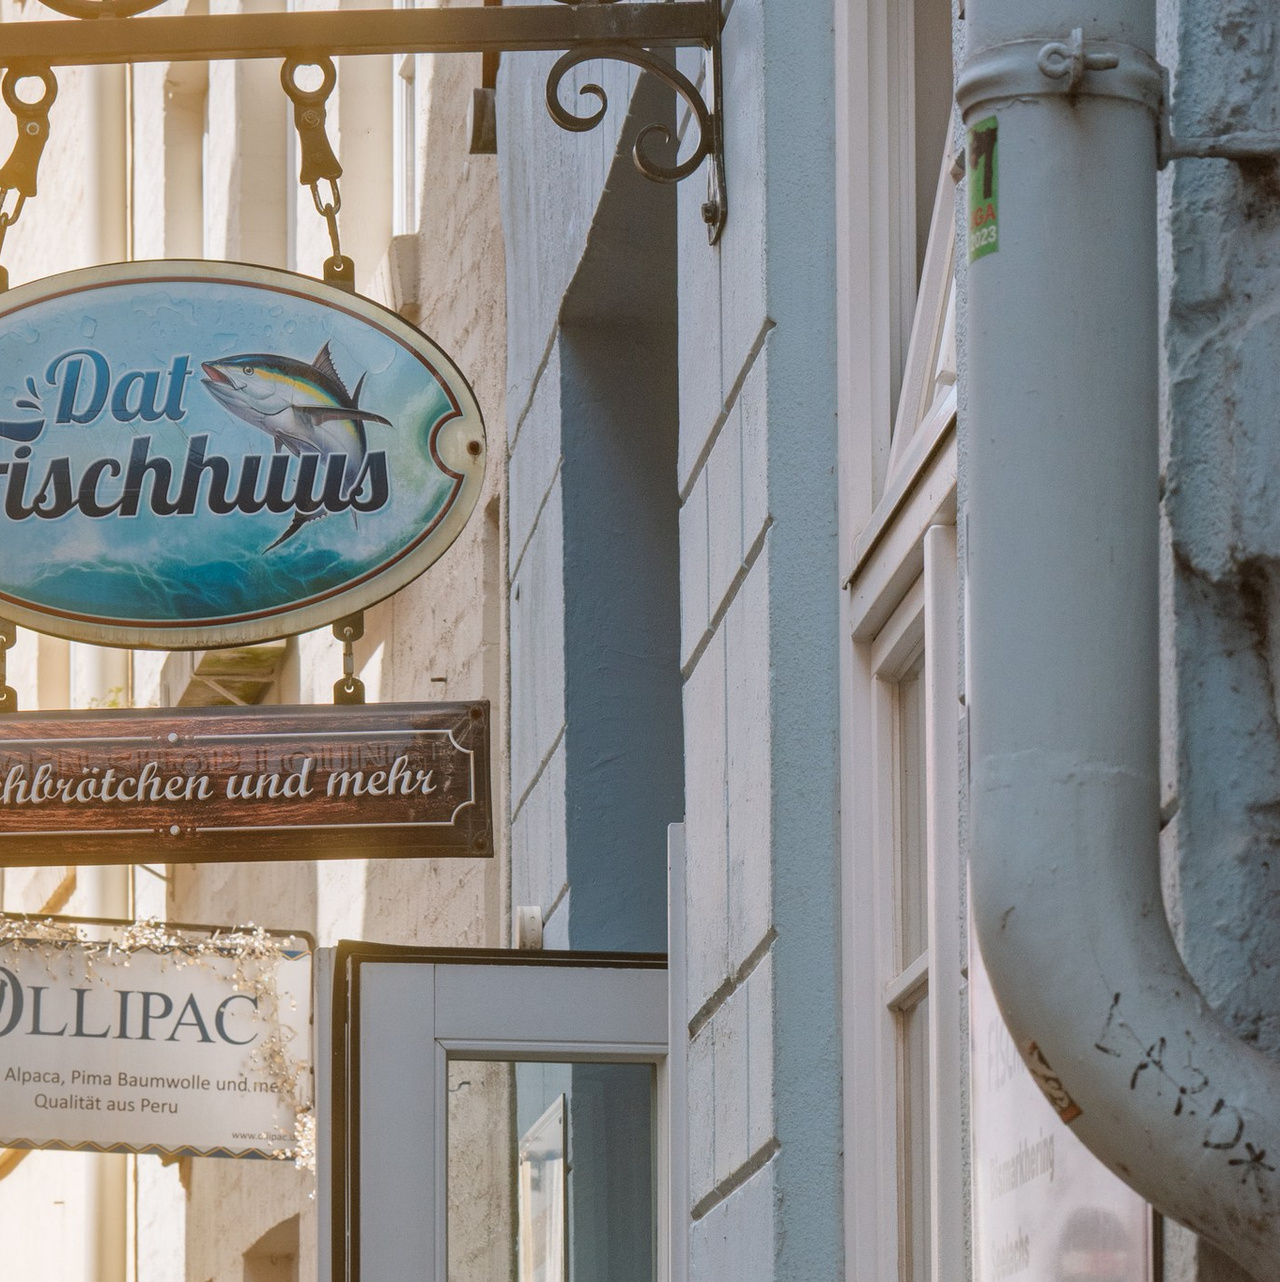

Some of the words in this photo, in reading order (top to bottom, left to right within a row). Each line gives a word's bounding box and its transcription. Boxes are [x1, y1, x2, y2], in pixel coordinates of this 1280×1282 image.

[46, 348, 194, 425] Dat
[226, 757, 314, 799] und
[326, 754, 437, 798] mehr
[4, 1067, 65, 1087] Alpaca,
[70, 1069, 113, 1087] Pima
[118, 1072, 211, 1091] Baumwolle
[216, 1077, 248, 1092] und
[33, 1092, 101, 1113] Qualität
[106, 1099, 135, 1114] aus
[140, 1098, 179, 1115] Peru
